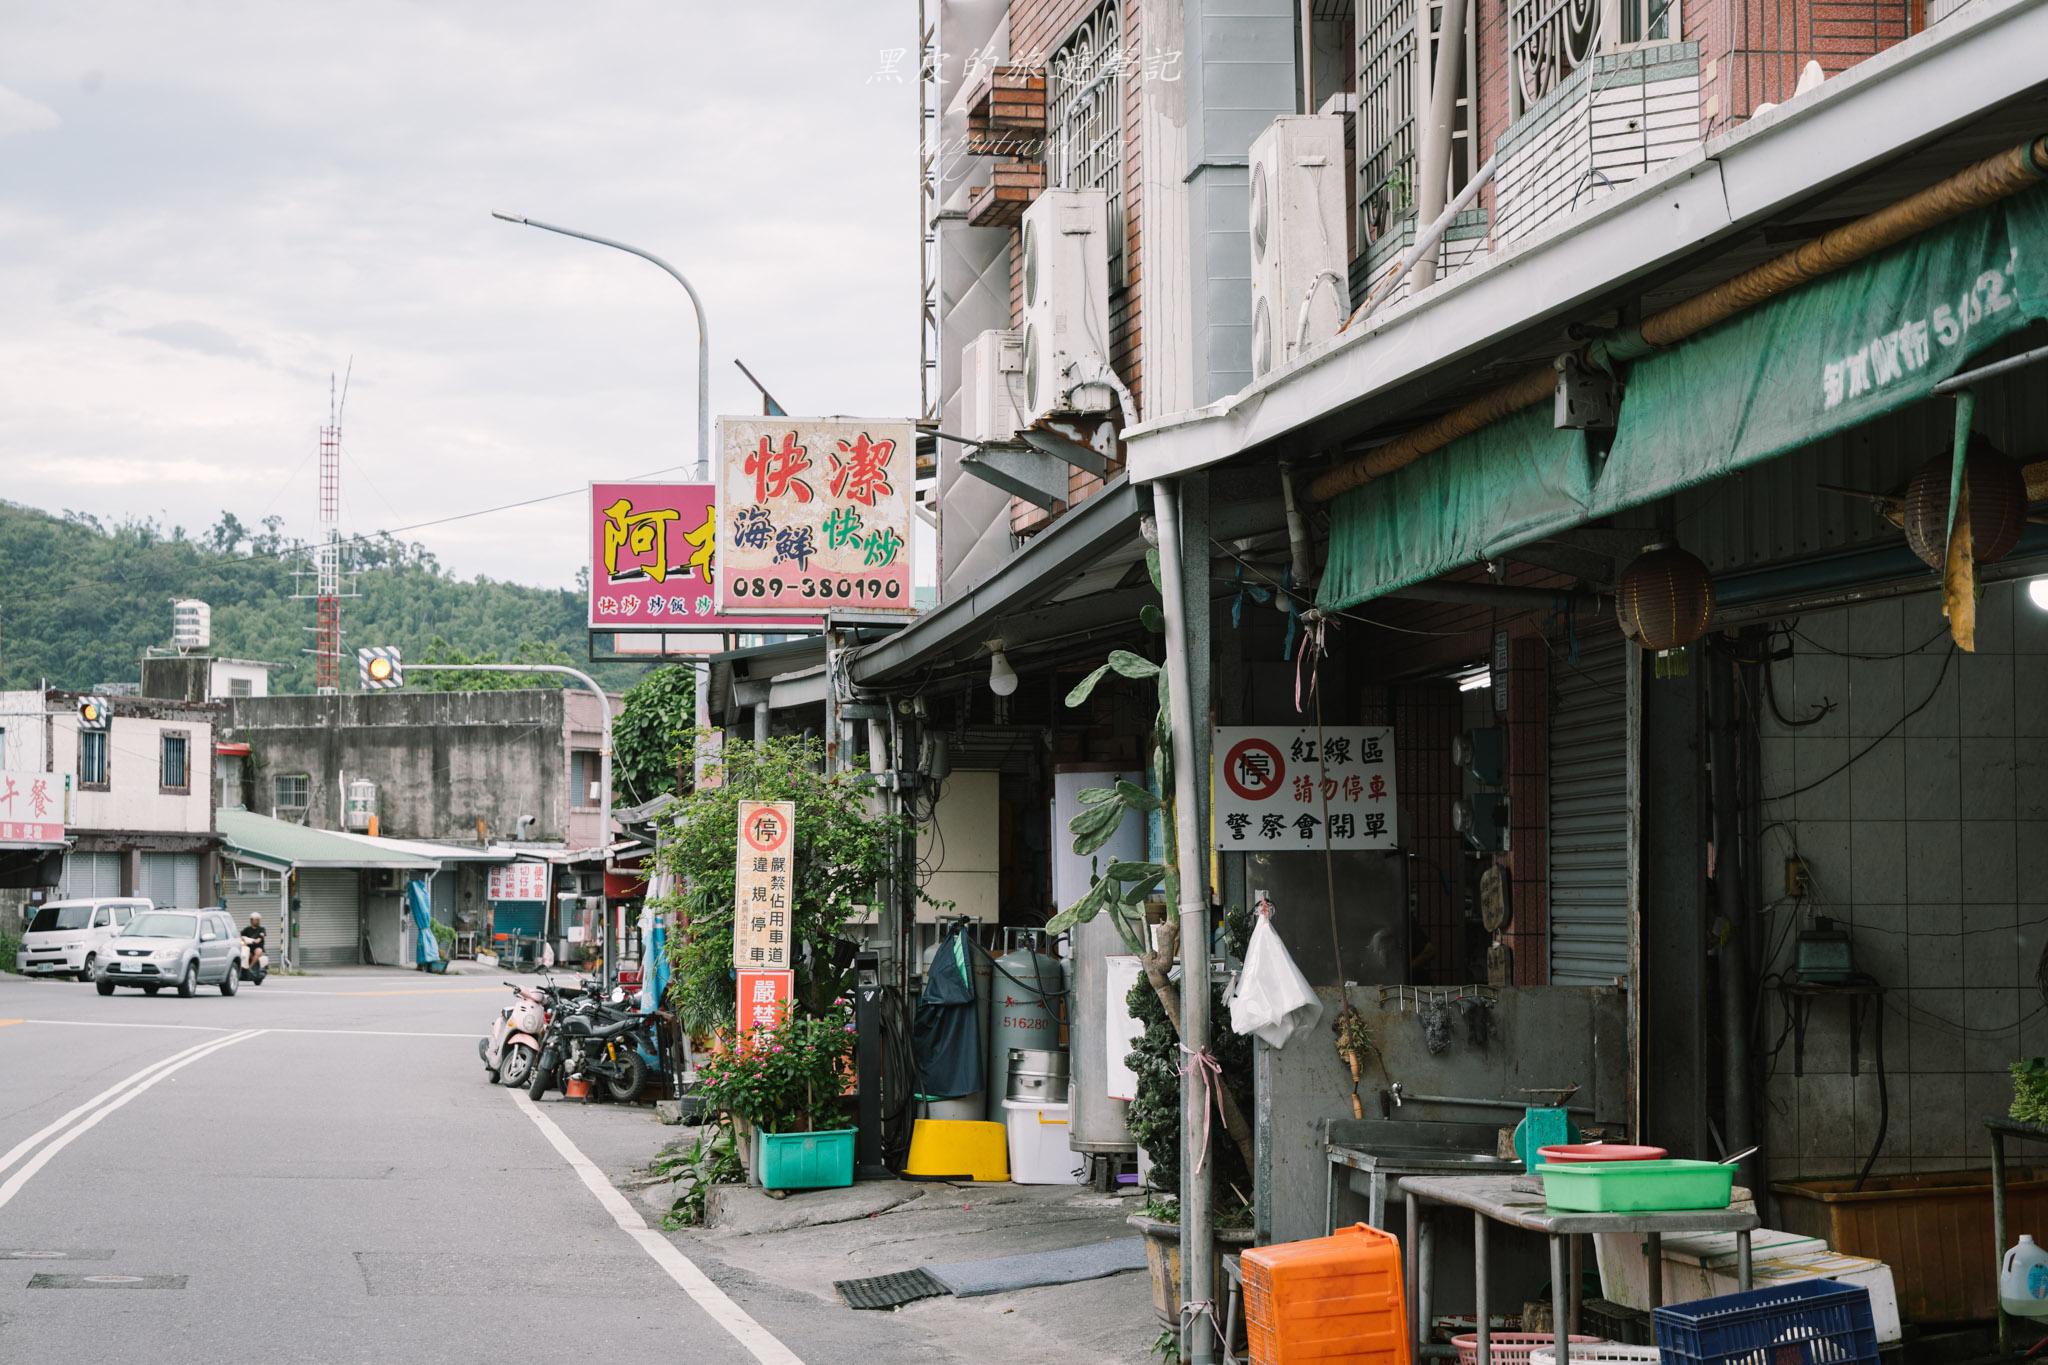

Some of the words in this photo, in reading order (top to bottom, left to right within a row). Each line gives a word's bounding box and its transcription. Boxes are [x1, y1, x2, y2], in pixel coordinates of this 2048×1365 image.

[744, 432, 896, 507] 快潔
[734, 505, 904, 572] 海鮮快炒
[733, 577, 900, 599] 089-380190
[598, 596, 640, 616] 快炒
[647, 595, 688, 616] 炒飯
[1291, 737, 1388, 765] 紅線區
[1238, 753, 1270, 785] 停
[1293, 774, 1387, 803] 請勿停車
[754, 818, 778, 842] 停
[1224, 813, 1388, 840] 警察會開單
[750, 857, 767, 962] 違規停車
[769, 857, 786, 963] 嚴禁佔用車道
[1003, 1016, 1047, 1029] 516280
